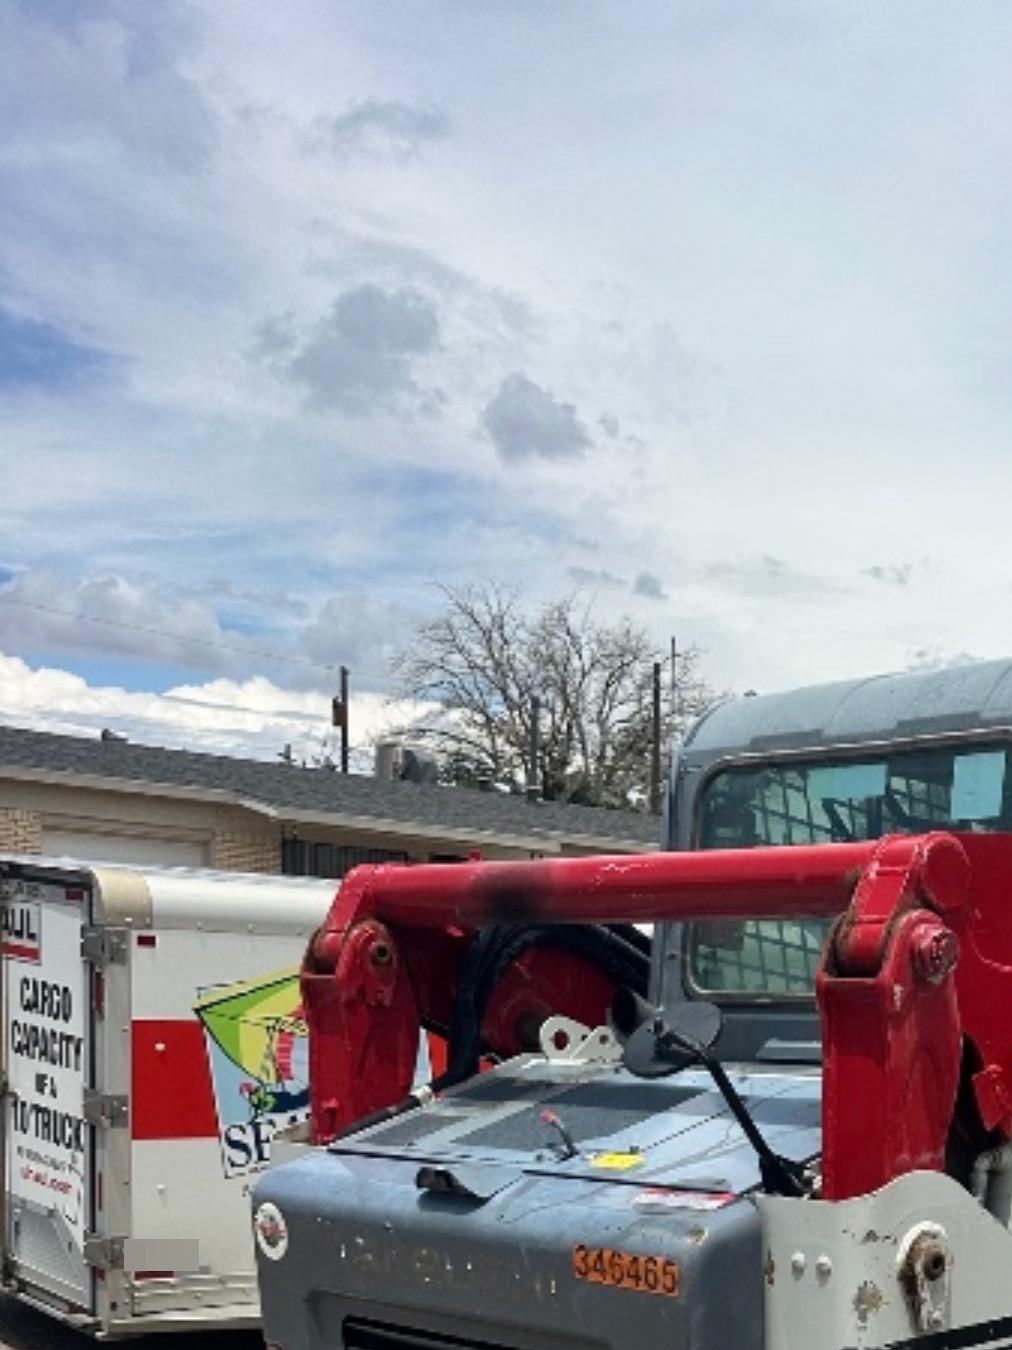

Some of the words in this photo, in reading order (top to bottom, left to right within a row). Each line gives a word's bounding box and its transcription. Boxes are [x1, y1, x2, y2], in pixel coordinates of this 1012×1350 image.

[20, 975, 73, 1023] CARGO
[11, 1018, 84, 1073] CAPACITY
[575, 1243, 677, 1293] 346465
